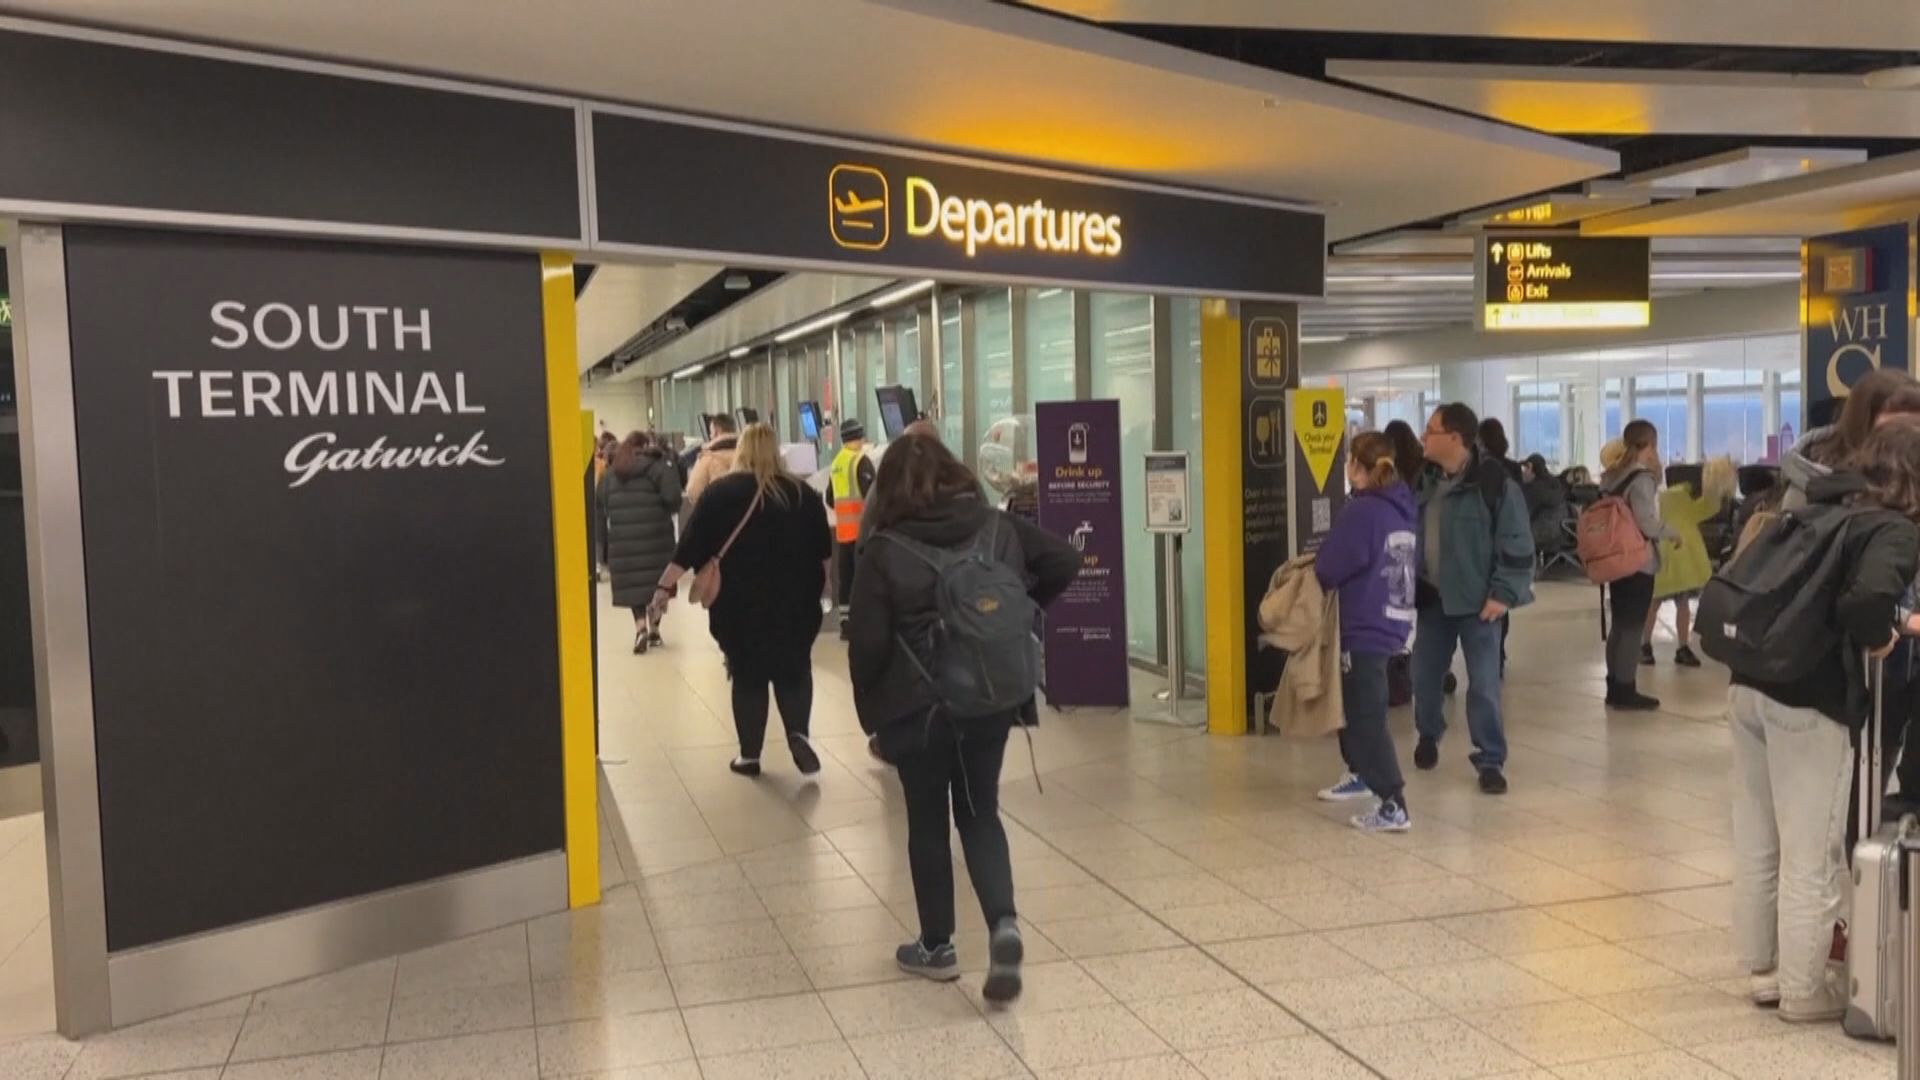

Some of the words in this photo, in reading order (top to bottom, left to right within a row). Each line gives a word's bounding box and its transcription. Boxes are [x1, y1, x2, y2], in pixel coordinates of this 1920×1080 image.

[906, 176, 1122, 257] Departures
[1525, 243, 1552, 260] Lifts
[1526, 263, 1572, 279] Arrivals
[1526, 284, 1549, 299] Exit
[210, 301, 432, 351] SOUTH
[1827, 303, 1888, 343] WH
[152, 370, 486, 418] TERMINAL
[284, 429, 506, 488] Gatwick
[1055, 466, 1085, 478] Drink
[1088, 467, 1103, 479] up
[1077, 480, 1110, 489] SECURITY
[1083, 555, 1099, 567] up
